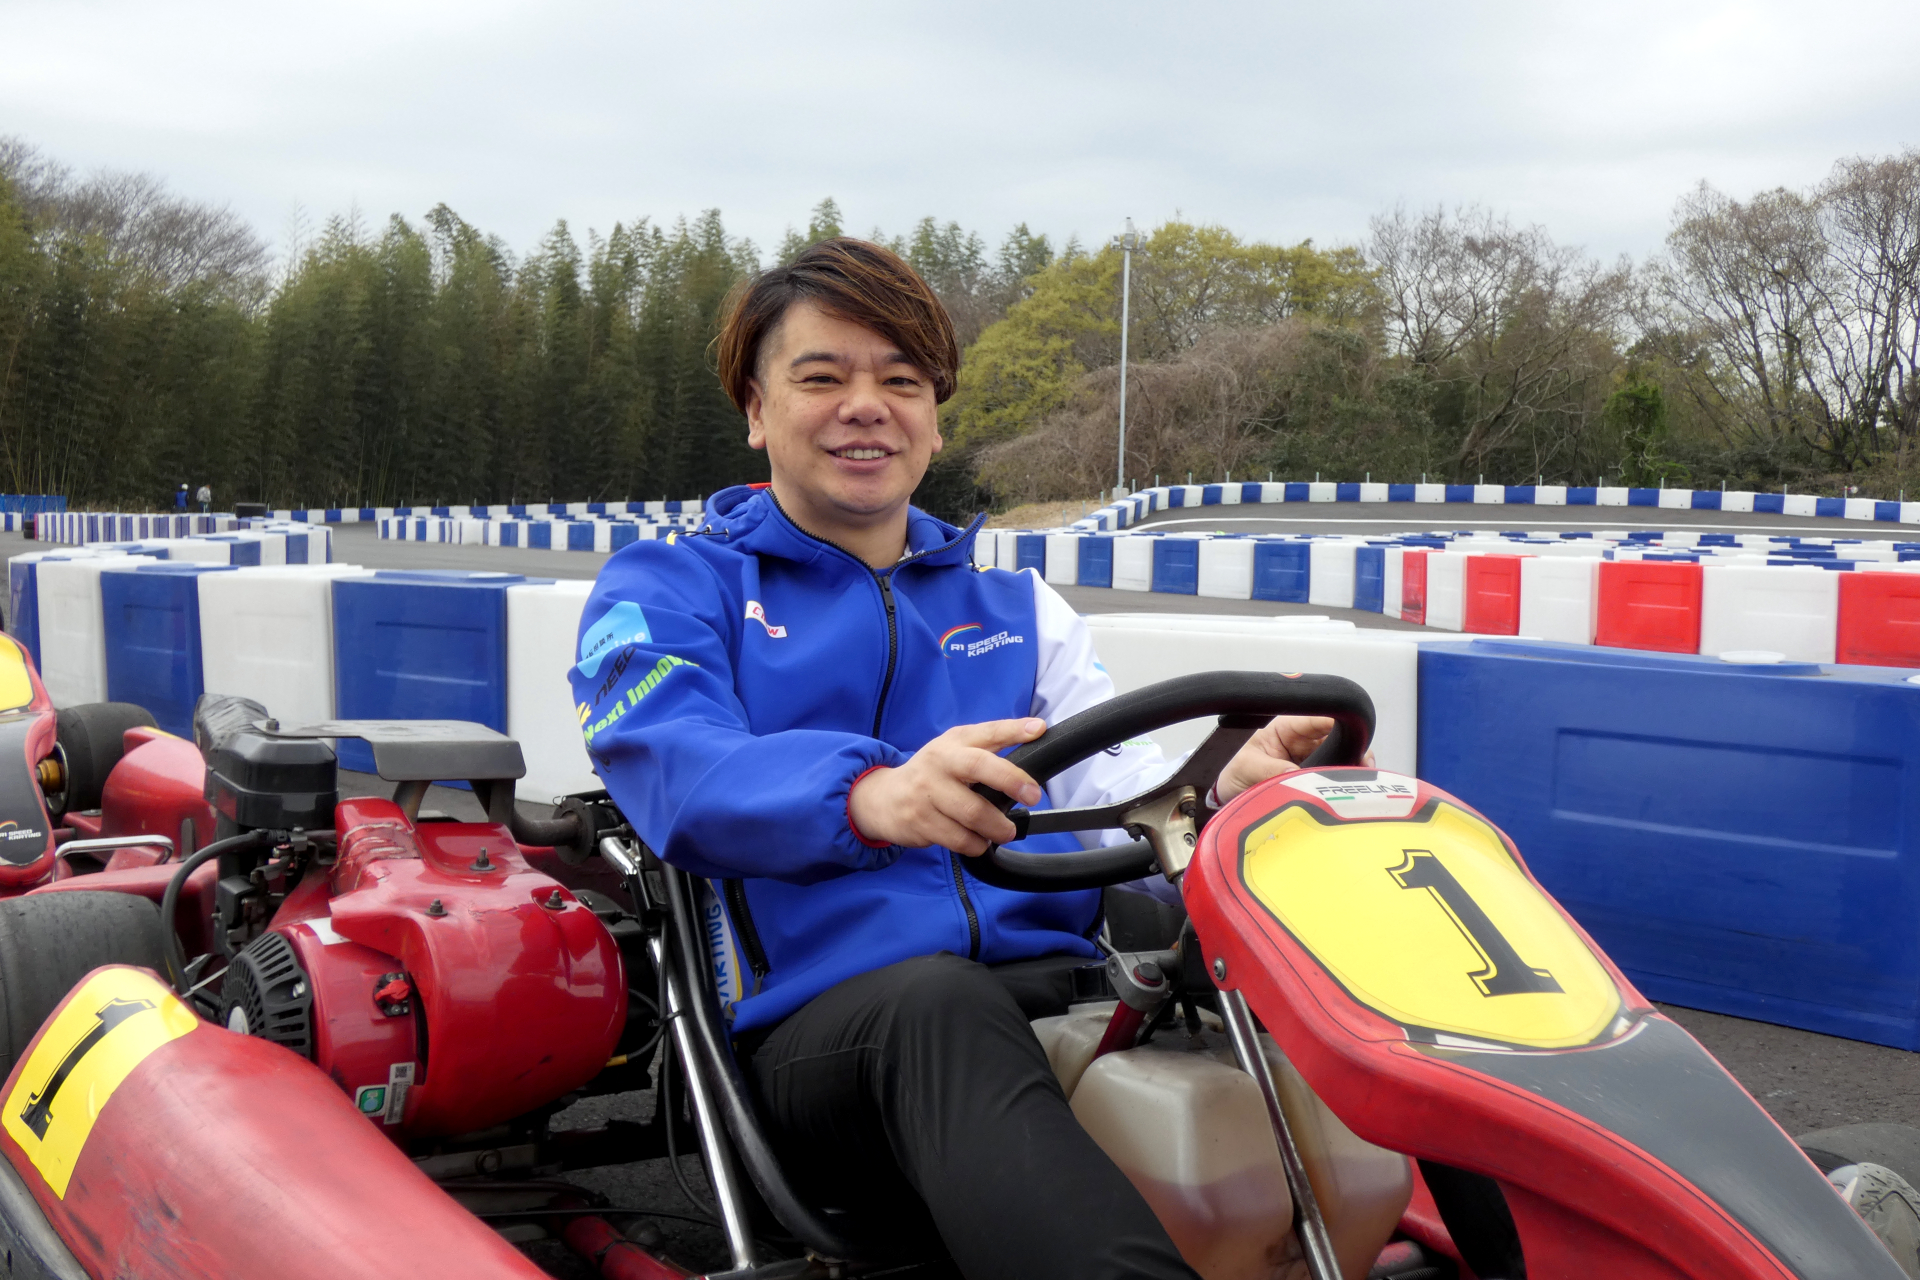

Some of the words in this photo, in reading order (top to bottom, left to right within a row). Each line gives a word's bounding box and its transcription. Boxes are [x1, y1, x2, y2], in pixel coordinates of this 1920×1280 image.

[950, 643, 965, 651] R1
[967, 630, 1008, 651] SPEED
[967, 635, 1024, 658] KARTING
[584, 700, 627, 746] Next
[626, 654, 698, 707] Innov
[1315, 784, 1411, 796] FREELINE
[1385, 848, 1566, 998] 1
[19, 997, 158, 1142] 1
